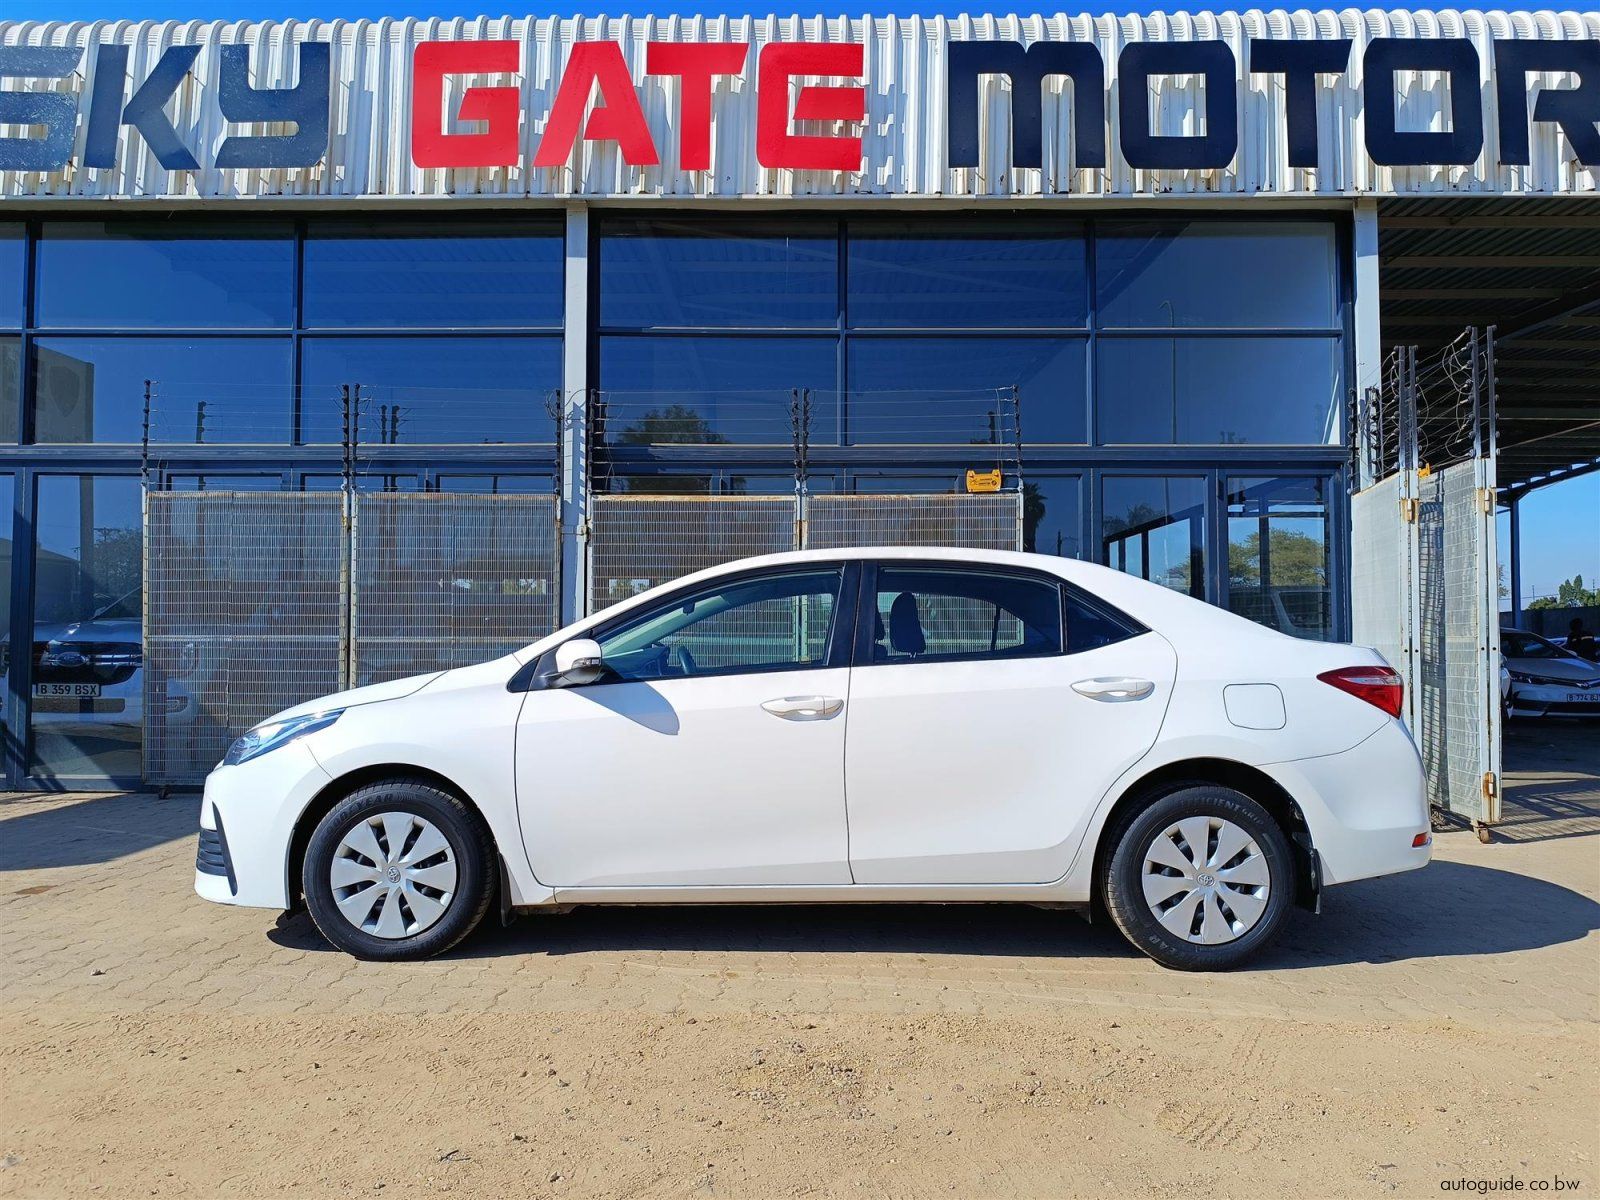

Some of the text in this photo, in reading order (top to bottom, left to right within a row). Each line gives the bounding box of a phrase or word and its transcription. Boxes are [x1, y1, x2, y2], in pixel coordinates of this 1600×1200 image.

[0, 41, 330, 171] SKY
[412, 40, 864, 171] GATE
[40, 685, 97, 695] B 359 BSX
